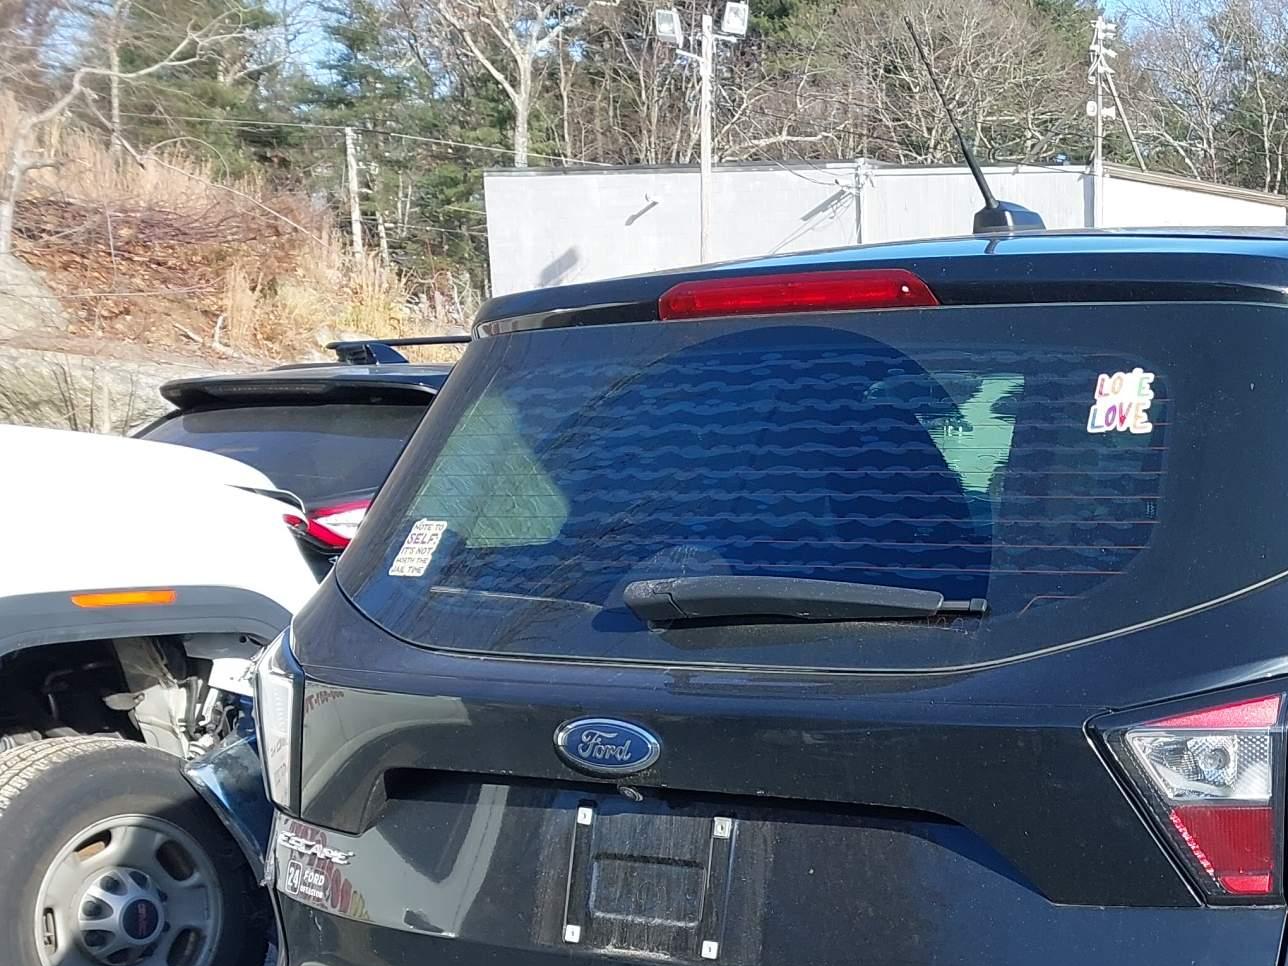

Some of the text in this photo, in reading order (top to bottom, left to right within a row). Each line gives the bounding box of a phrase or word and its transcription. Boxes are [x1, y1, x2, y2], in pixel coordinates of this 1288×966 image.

[1098, 375, 1151, 398] LOE
[1090, 401, 1149, 430] LOVE
[416, 546, 433, 555] NOT
[578, 729, 632, 760] Ford
[279, 831, 355, 865] ESCAPE
[287, 866, 300, 888] 24
[303, 869, 325, 887] FORD
